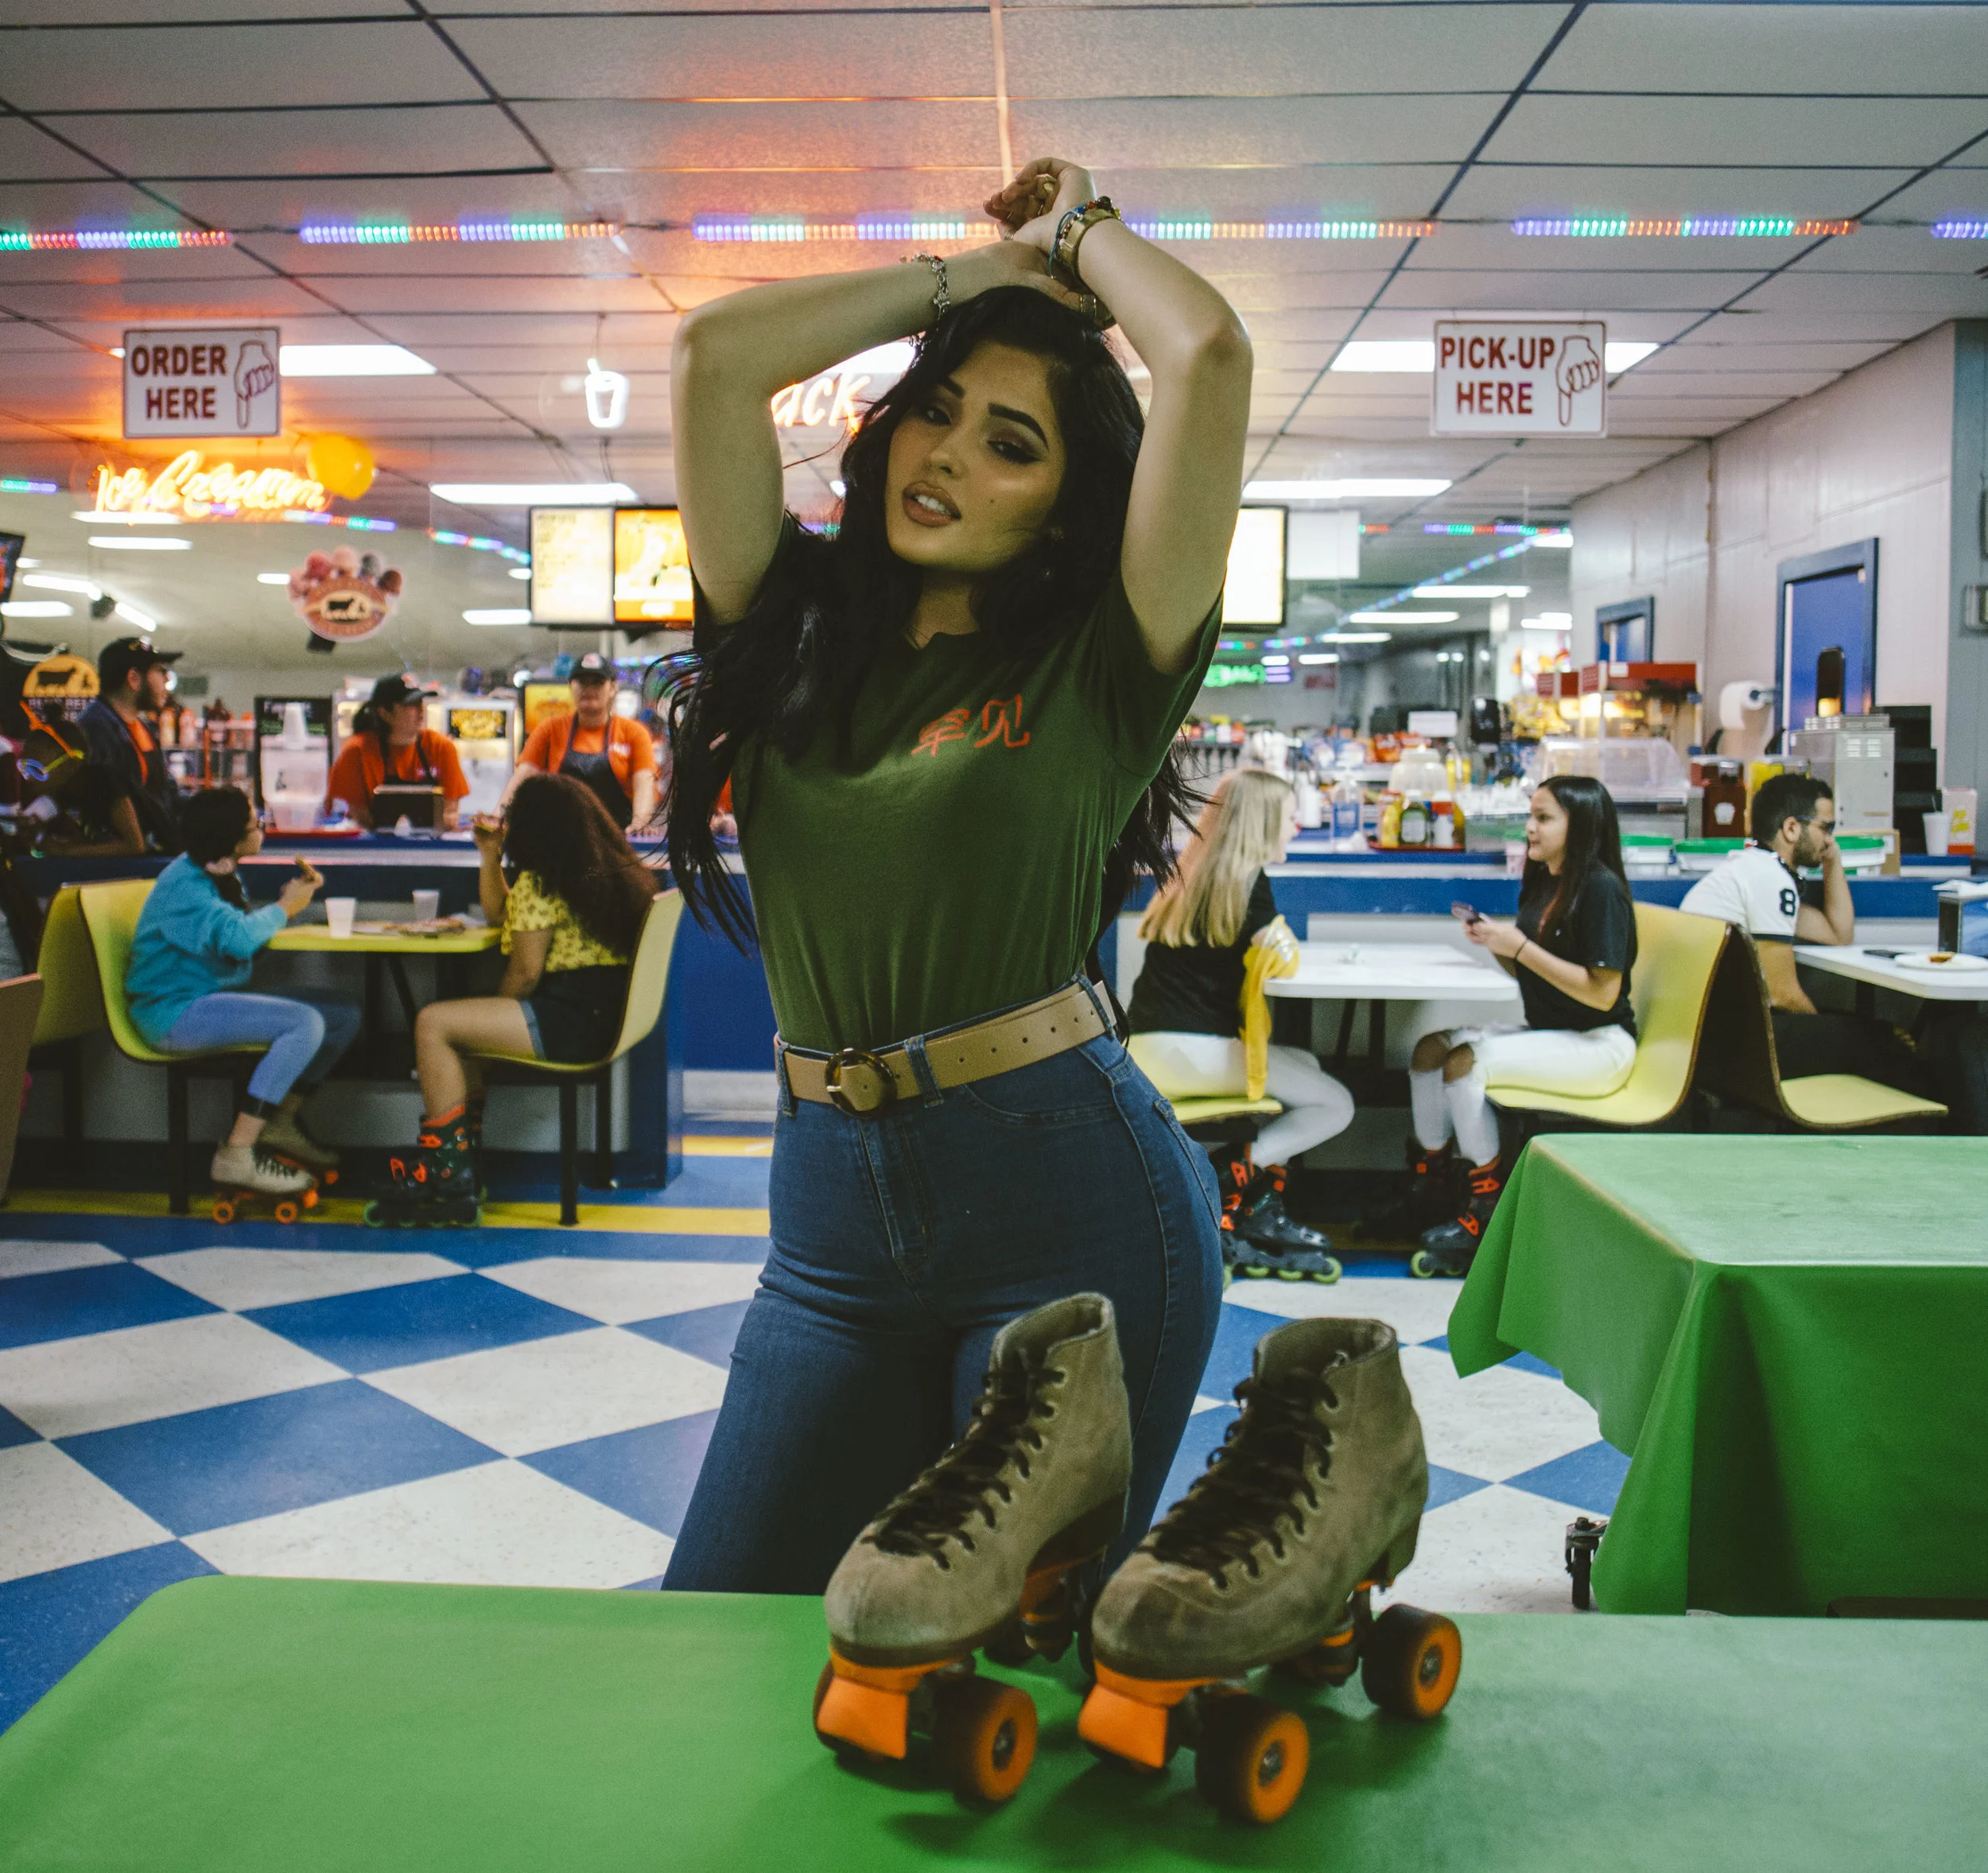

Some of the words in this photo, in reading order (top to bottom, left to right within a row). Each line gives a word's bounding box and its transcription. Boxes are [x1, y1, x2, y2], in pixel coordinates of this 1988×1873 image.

[131, 345, 227, 376] ORDER
[1440, 336, 1555, 369] PICK-UP
[146, 387, 215, 419] HERE
[1457, 381, 1533, 414] HERE
[95, 464, 147, 511] Ice
[1779, 888, 1797, 917] 8
